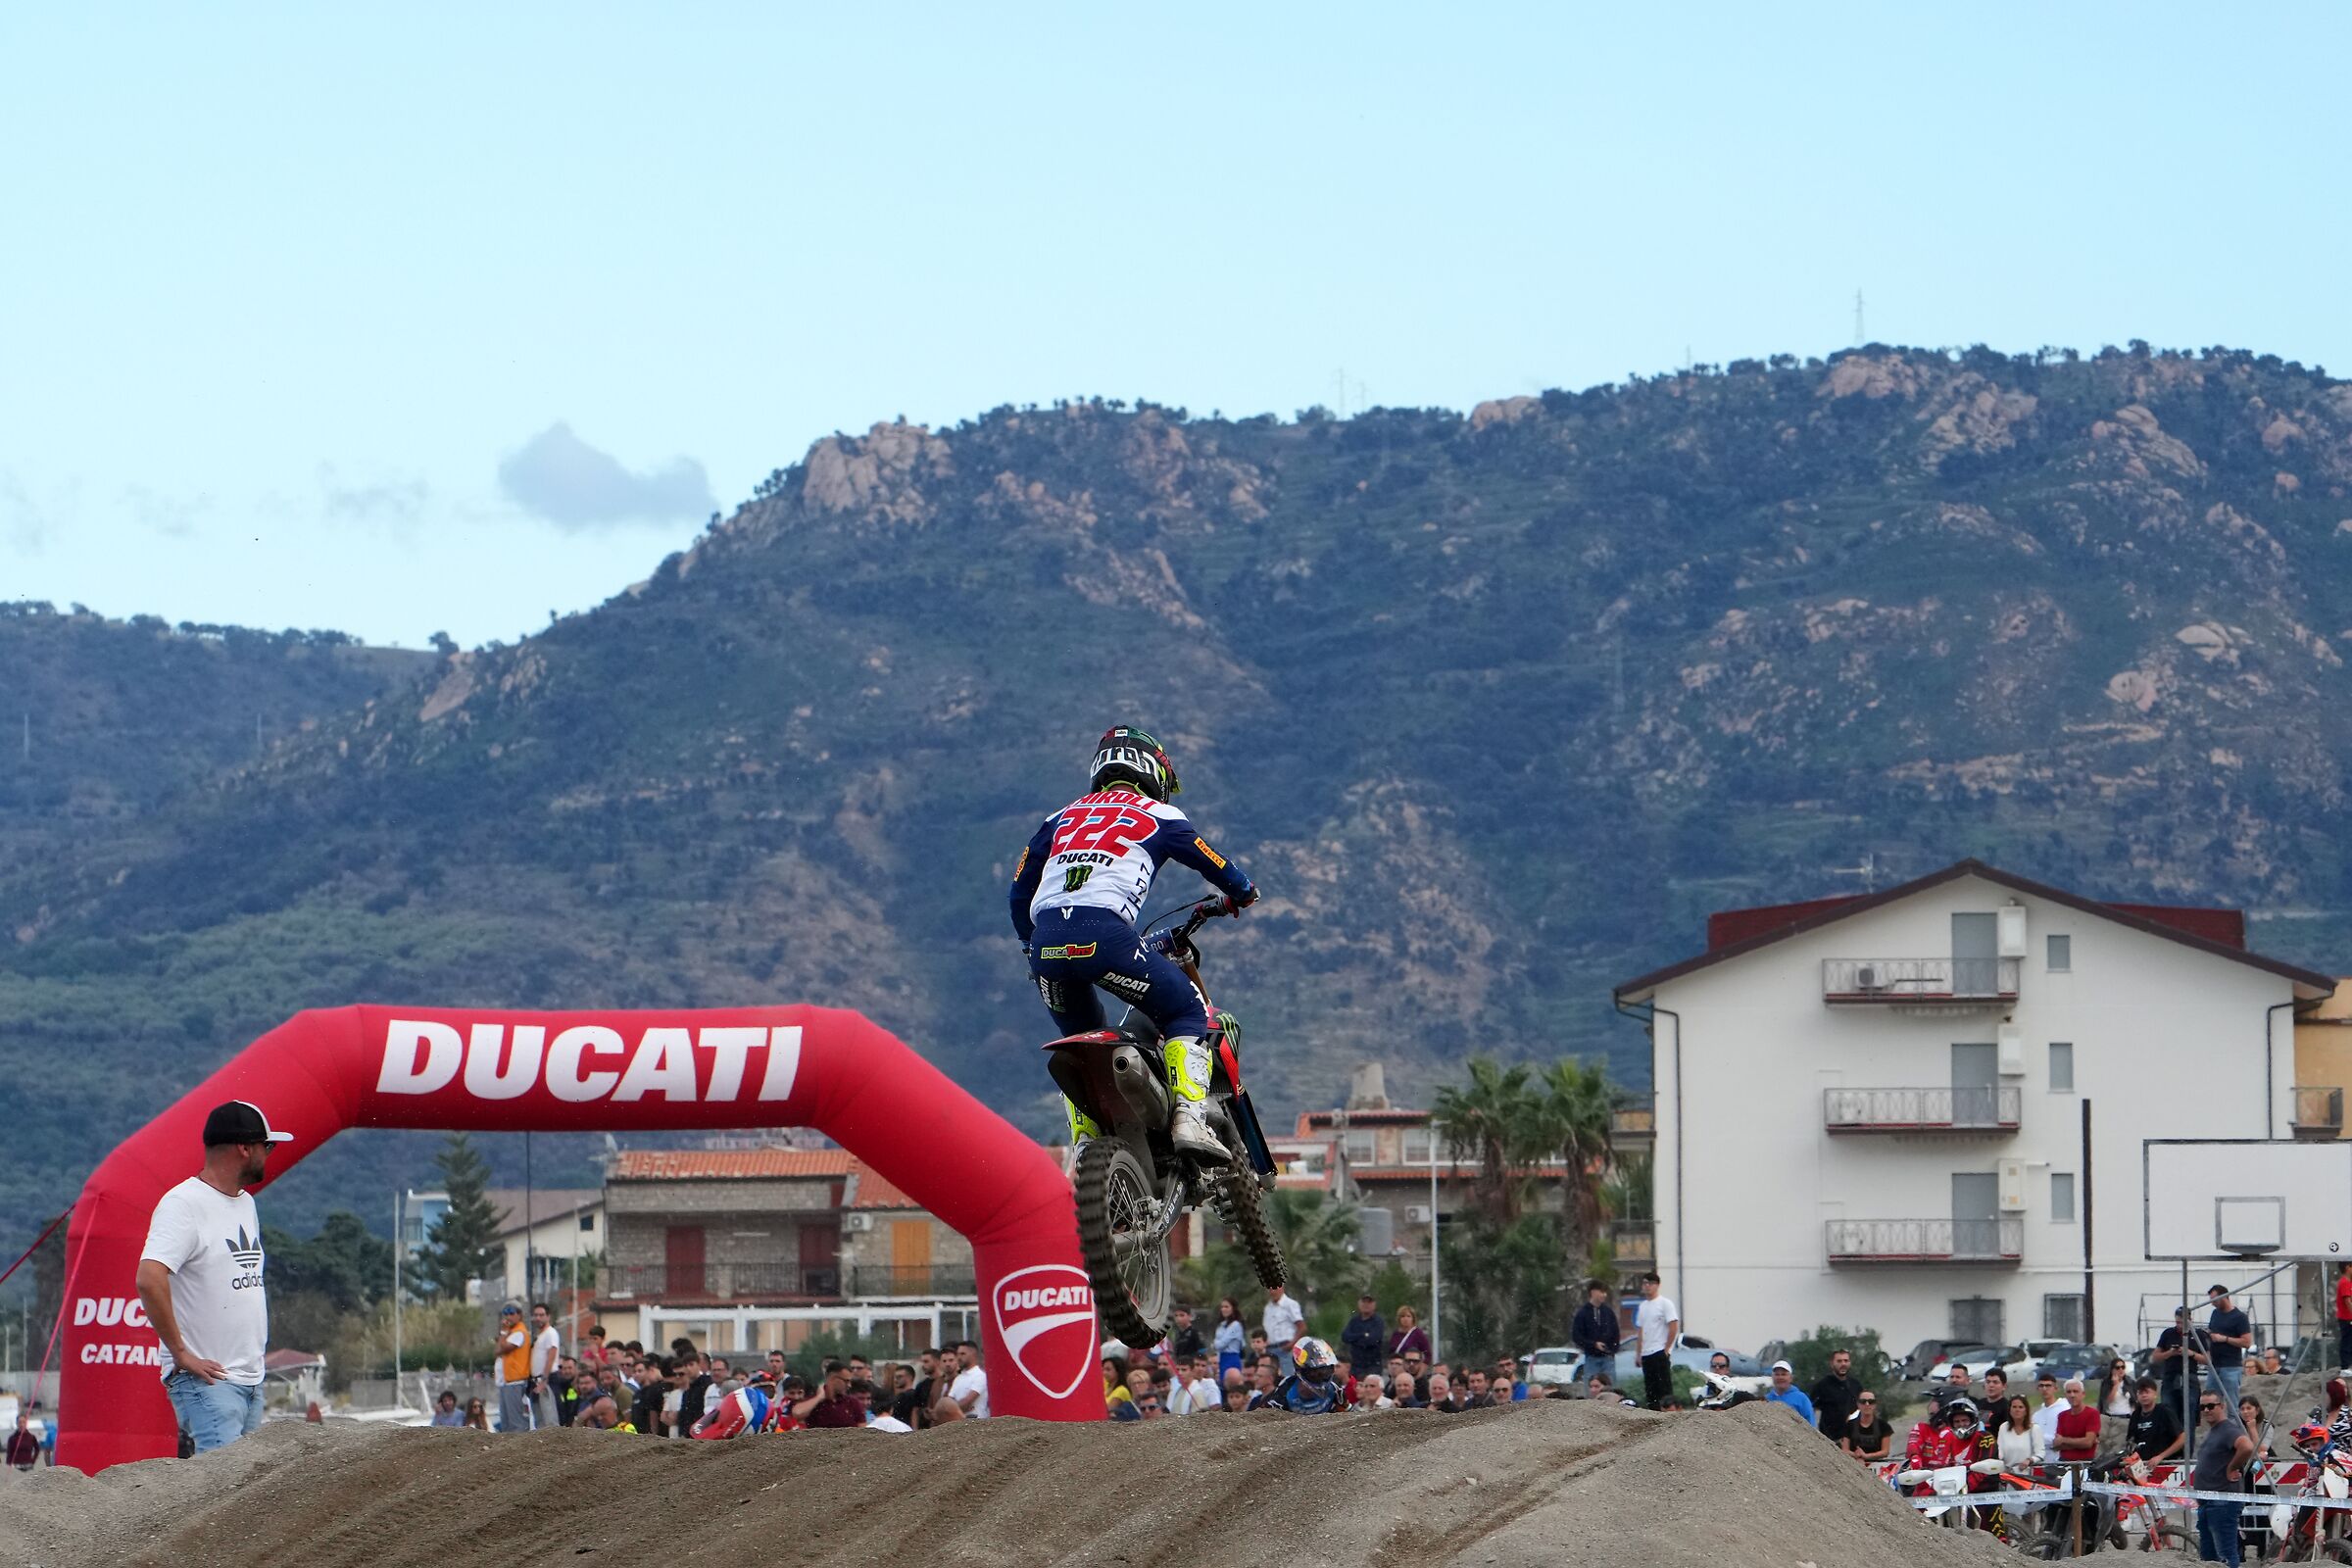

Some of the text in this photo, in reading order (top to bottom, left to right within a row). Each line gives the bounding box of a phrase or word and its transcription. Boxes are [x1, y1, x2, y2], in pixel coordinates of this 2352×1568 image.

[1071, 791, 1157, 812] AIROLI
[1050, 807, 1159, 858] 222
[1056, 853, 1114, 867] DUCATI
[1103, 971, 1151, 993] DUCATI
[375, 1019, 803, 1102] DUCATI
[1004, 1286, 1088, 1311] DUCATI
